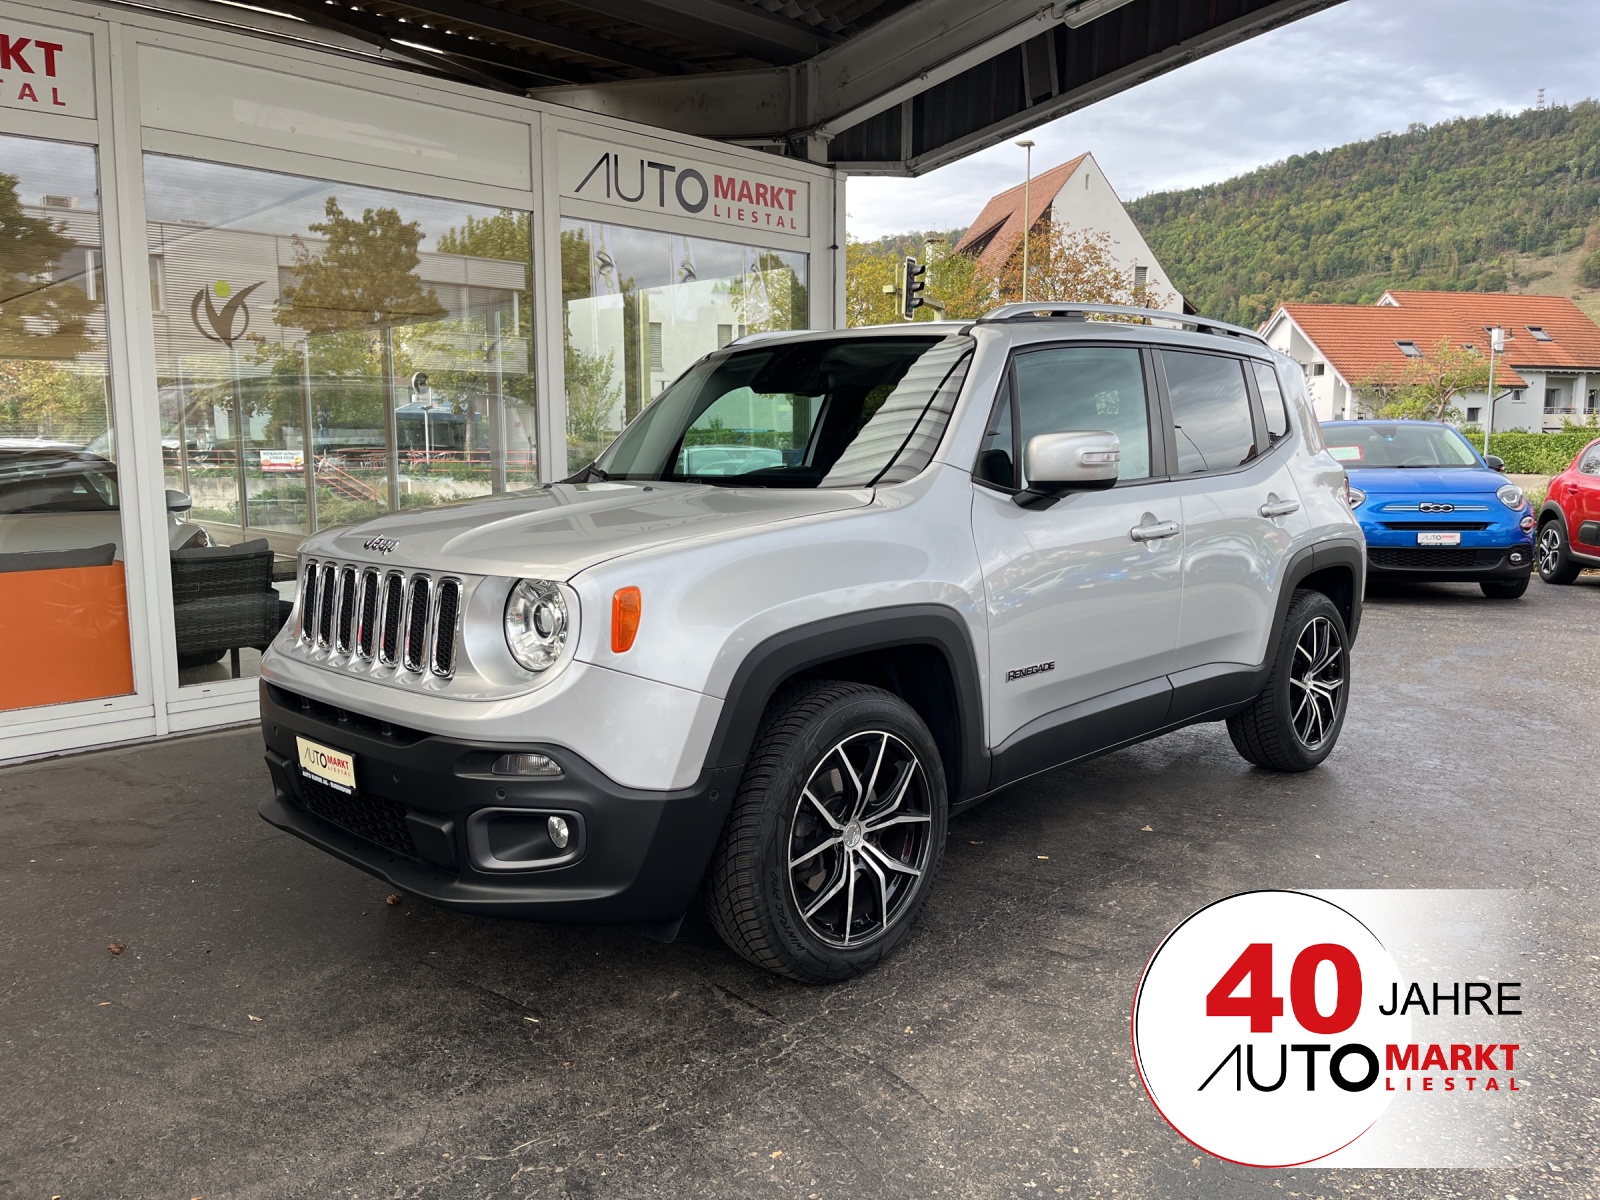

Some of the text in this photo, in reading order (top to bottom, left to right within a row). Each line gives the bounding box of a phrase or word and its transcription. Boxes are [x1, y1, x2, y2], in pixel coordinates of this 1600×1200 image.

[0, 79, 66, 106] AL
[574, 152, 797, 213] AUTO MARKT
[714, 204, 797, 230] LIESTAL
[1420, 502, 1454, 513] 500
[363, 534, 400, 556] Jeep
[1006, 661, 1055, 682] RENEGADE
[328, 766, 351, 777] LIESTAL
[770, 870, 806, 951] WINTRAC PRO
